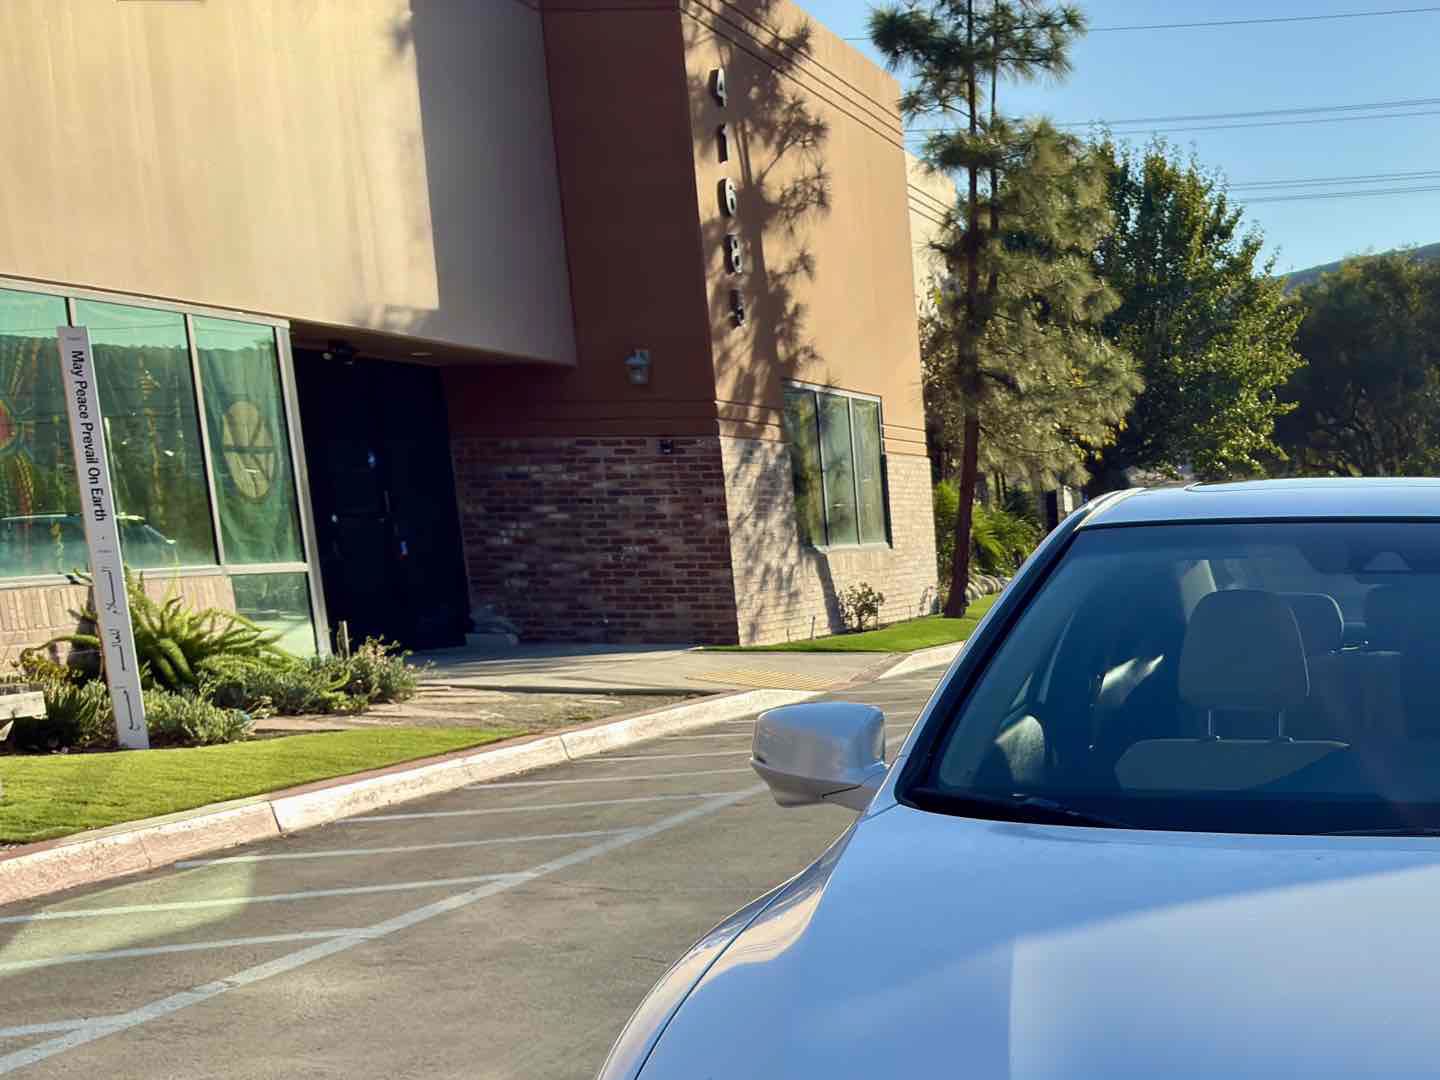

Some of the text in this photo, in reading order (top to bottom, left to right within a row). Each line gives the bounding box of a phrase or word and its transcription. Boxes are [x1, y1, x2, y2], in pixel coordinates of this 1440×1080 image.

[70, 350, 85, 377] May
[75, 380, 88, 419] Peace
[80, 422, 99, 464] Prevail
[87, 467, 101, 485] On
[91, 488, 107, 522] Earth
